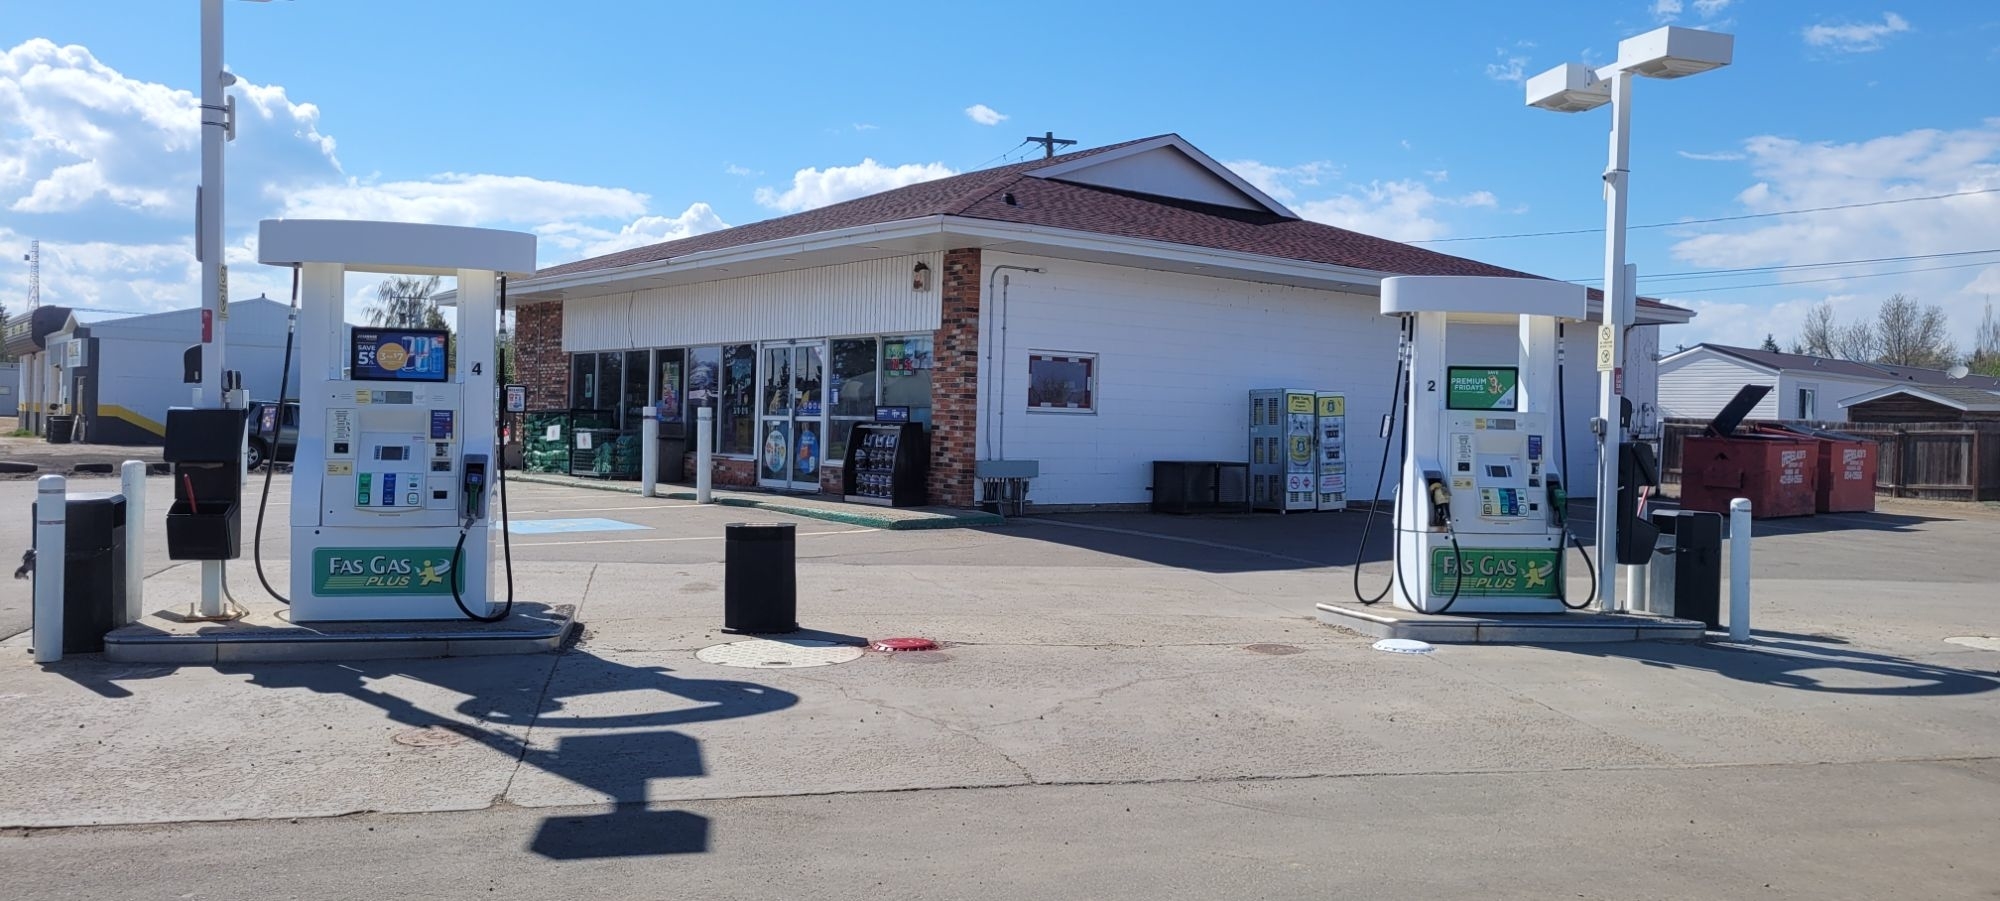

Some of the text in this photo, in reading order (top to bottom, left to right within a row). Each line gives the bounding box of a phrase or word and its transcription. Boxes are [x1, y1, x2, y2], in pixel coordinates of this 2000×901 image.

[471, 362, 482, 375] 4
[1427, 380, 1436, 391] 2
[329, 556, 411, 574] FAS GAS
[1479, 555, 1517, 576] GAS
[365, 576, 411, 586] PLUS
[1475, 577, 1517, 588] PLUS
